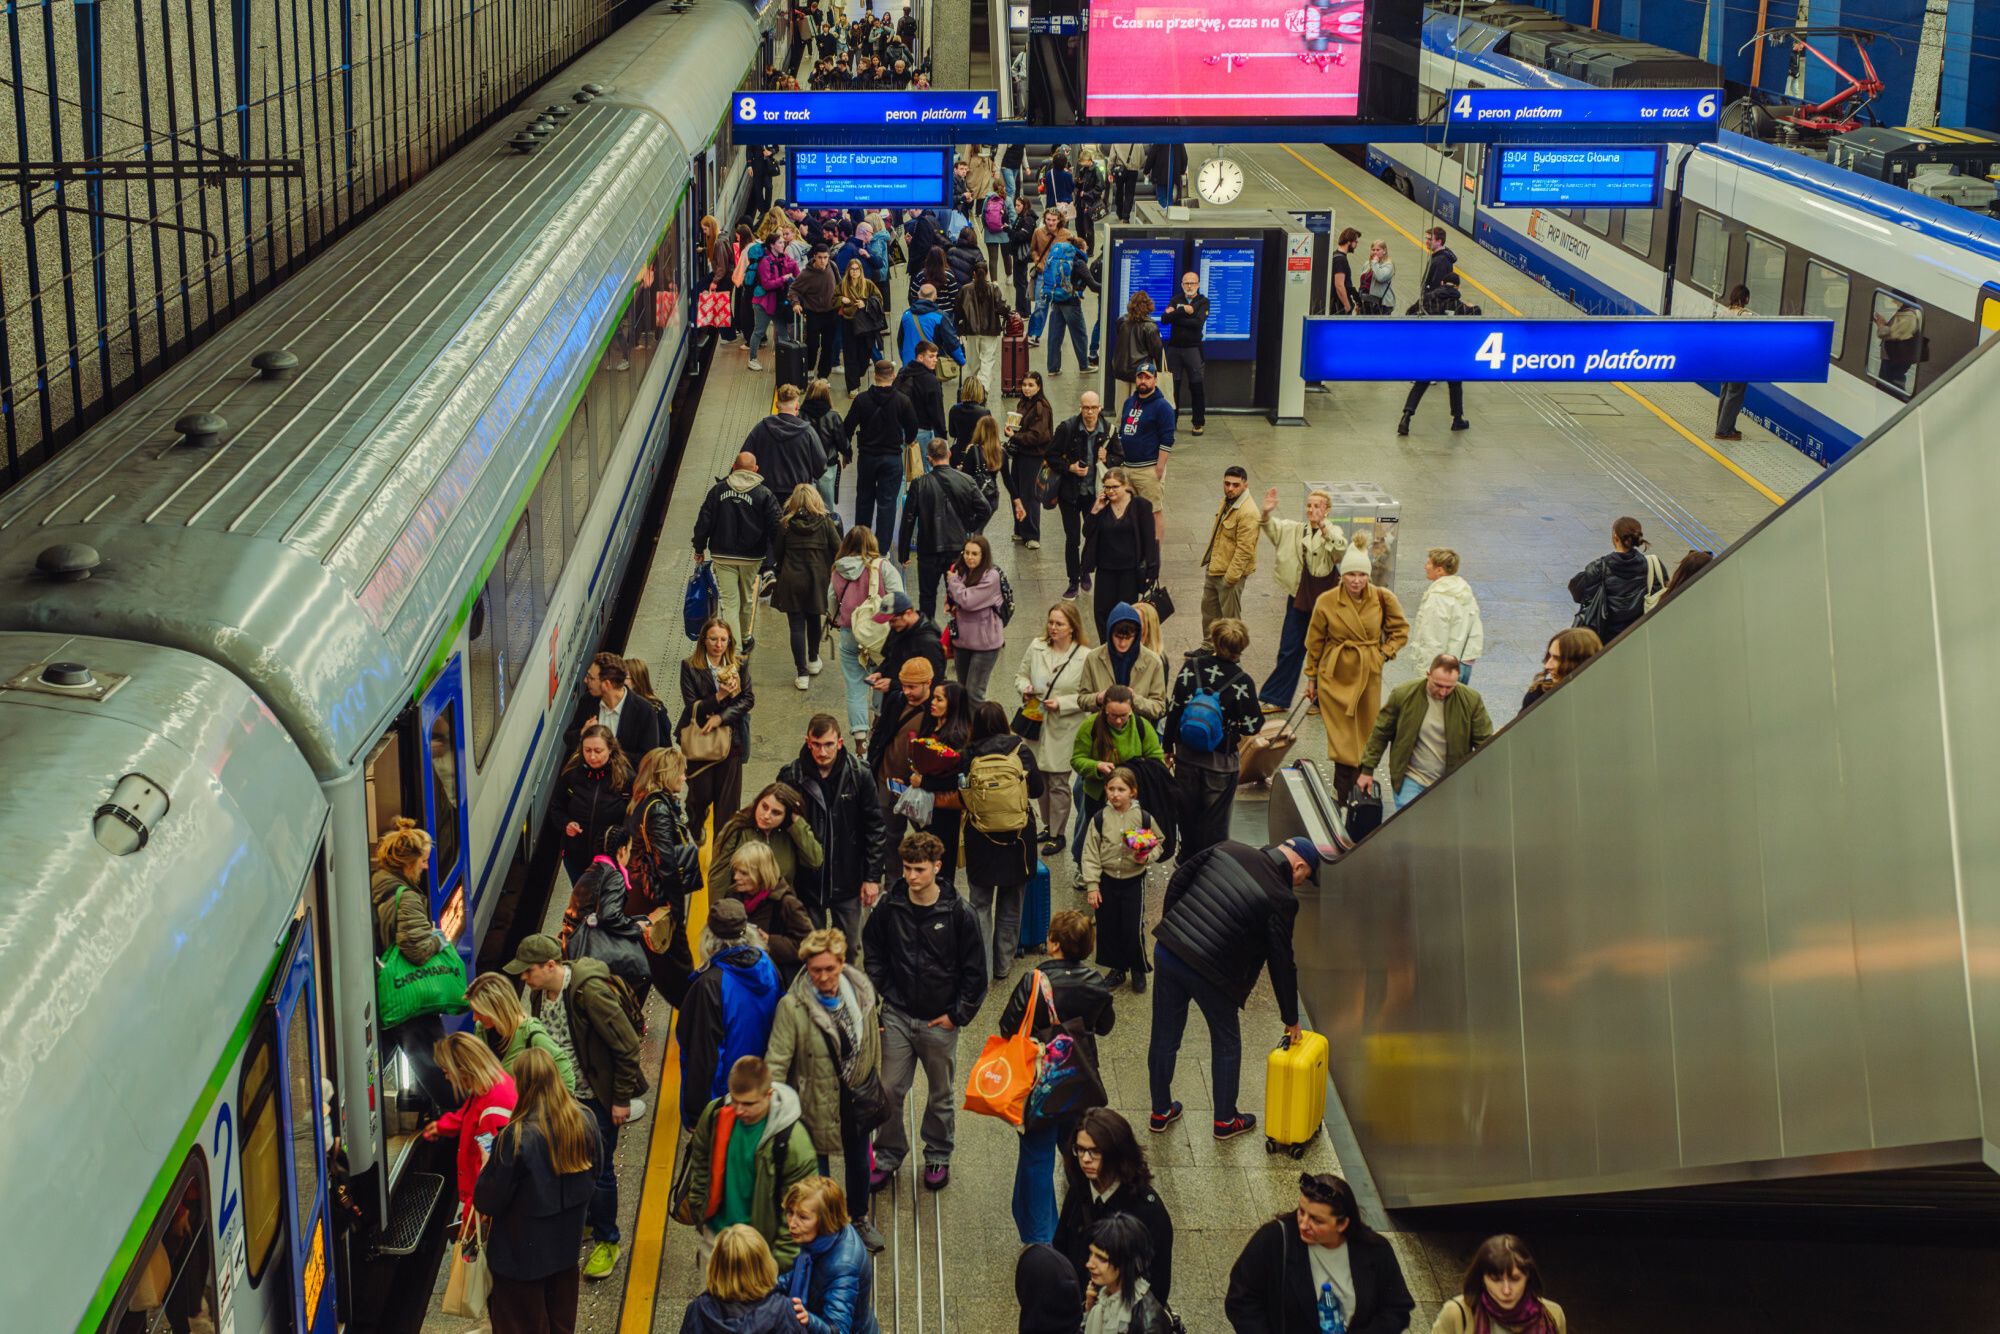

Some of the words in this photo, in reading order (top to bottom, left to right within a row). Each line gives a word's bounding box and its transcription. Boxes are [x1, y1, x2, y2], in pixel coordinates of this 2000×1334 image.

[1112, 16, 1143, 29] Czas
[1146, 18, 1163, 29] na
[1228, 18, 1258, 28] czas
[1261, 18, 1280, 28] na
[740, 97, 757, 120] 8
[763, 110, 780, 121] tor
[784, 108, 811, 121] track
[885, 110, 918, 123] peron
[921, 107, 967, 122] platform
[973, 96, 991, 119] 4
[1453, 95, 1473, 118] 4
[1478, 109, 1511, 121] peron
[1514, 106, 1563, 121] platform
[1640, 107, 1659, 118] tor
[1662, 106, 1691, 118] track
[1697, 94, 1716, 118] 6
[849, 153, 898, 165] Fabryczna
[1533, 151, 1585, 164] Bydgoszcz
[1547, 224, 1561, 242] PKP
[1560, 231, 1592, 261] INTERCITY
[1474, 332, 1507, 370] 4
[1511, 353, 1576, 374] peron
[1583, 348, 1677, 374] platform
[213, 1102, 238, 1239] 2
